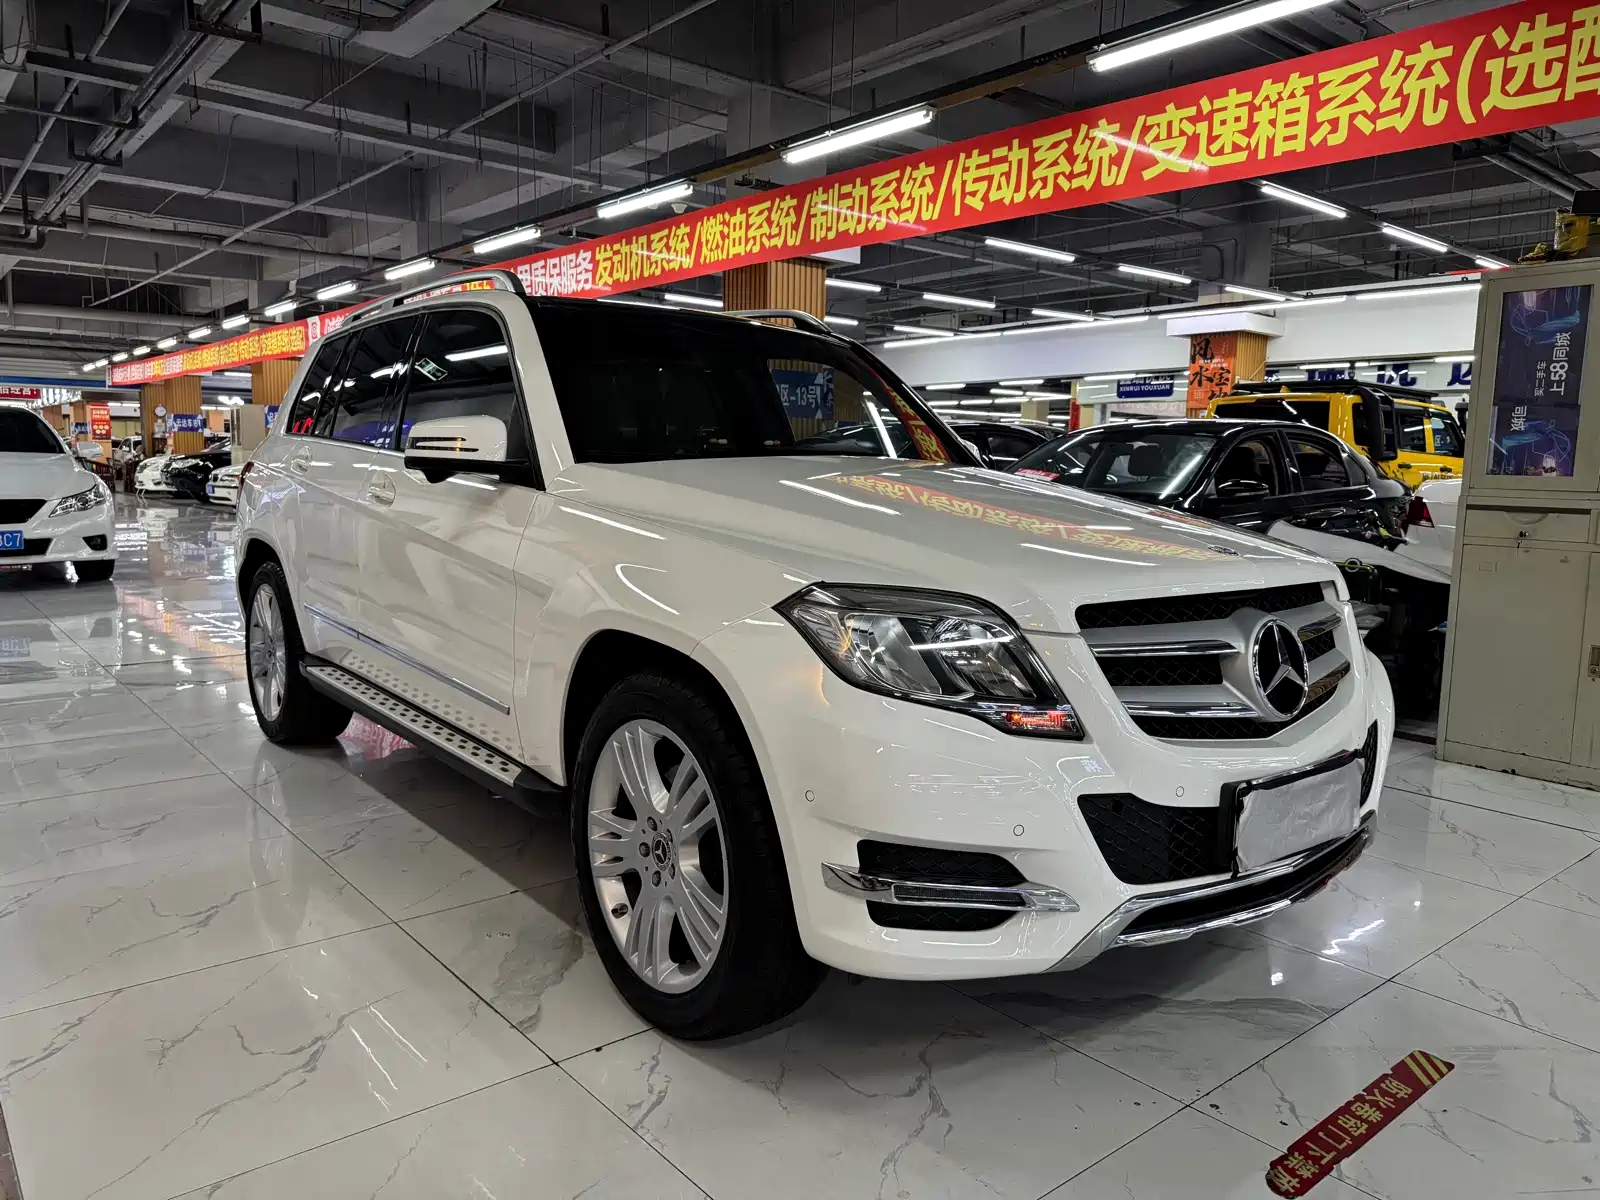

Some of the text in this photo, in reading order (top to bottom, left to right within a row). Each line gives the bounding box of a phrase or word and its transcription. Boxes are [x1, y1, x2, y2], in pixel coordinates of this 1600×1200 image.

[511, 250, 594, 297] 里质保服务
[1534, 360, 1547, 396] 买二手车
[1550, 331, 1571, 396] 上58同城
[776, 384, 817, 408] 区-13号
